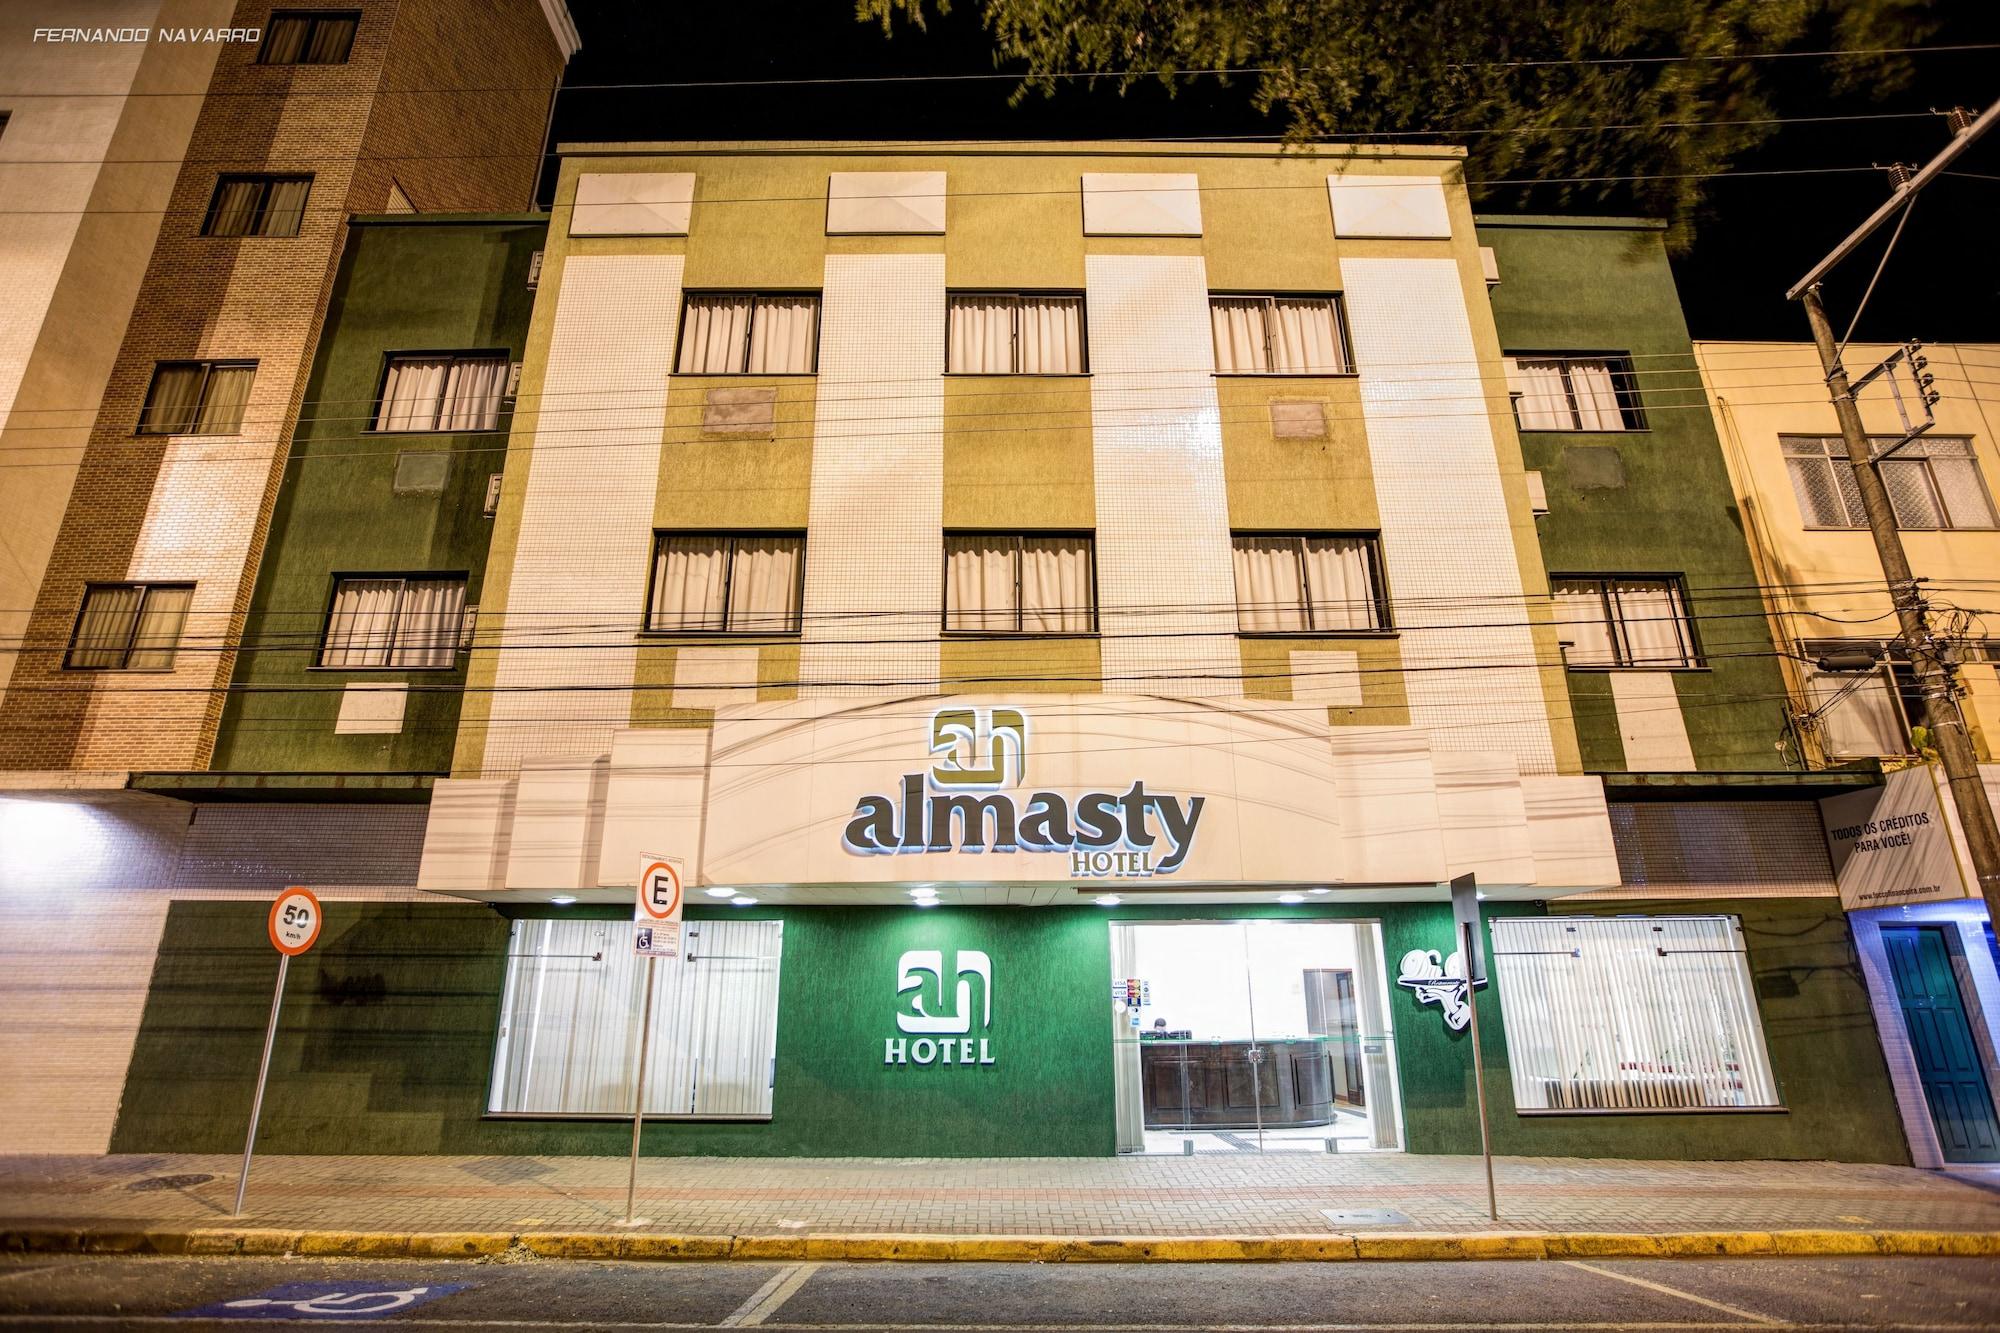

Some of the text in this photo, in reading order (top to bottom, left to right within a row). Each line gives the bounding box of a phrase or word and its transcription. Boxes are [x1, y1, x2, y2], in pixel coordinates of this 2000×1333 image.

[844, 773, 1206, 869] almasty
[1831, 812, 1929, 841] TODOS OS CRÉDITOS
[1854, 832, 1912, 854] PARA VOCÊ!
[1071, 851, 1154, 874] HOTEL
[653, 875, 669, 905] E
[283, 904, 309, 929] 50
[884, 1037, 996, 1065] HOTEL
